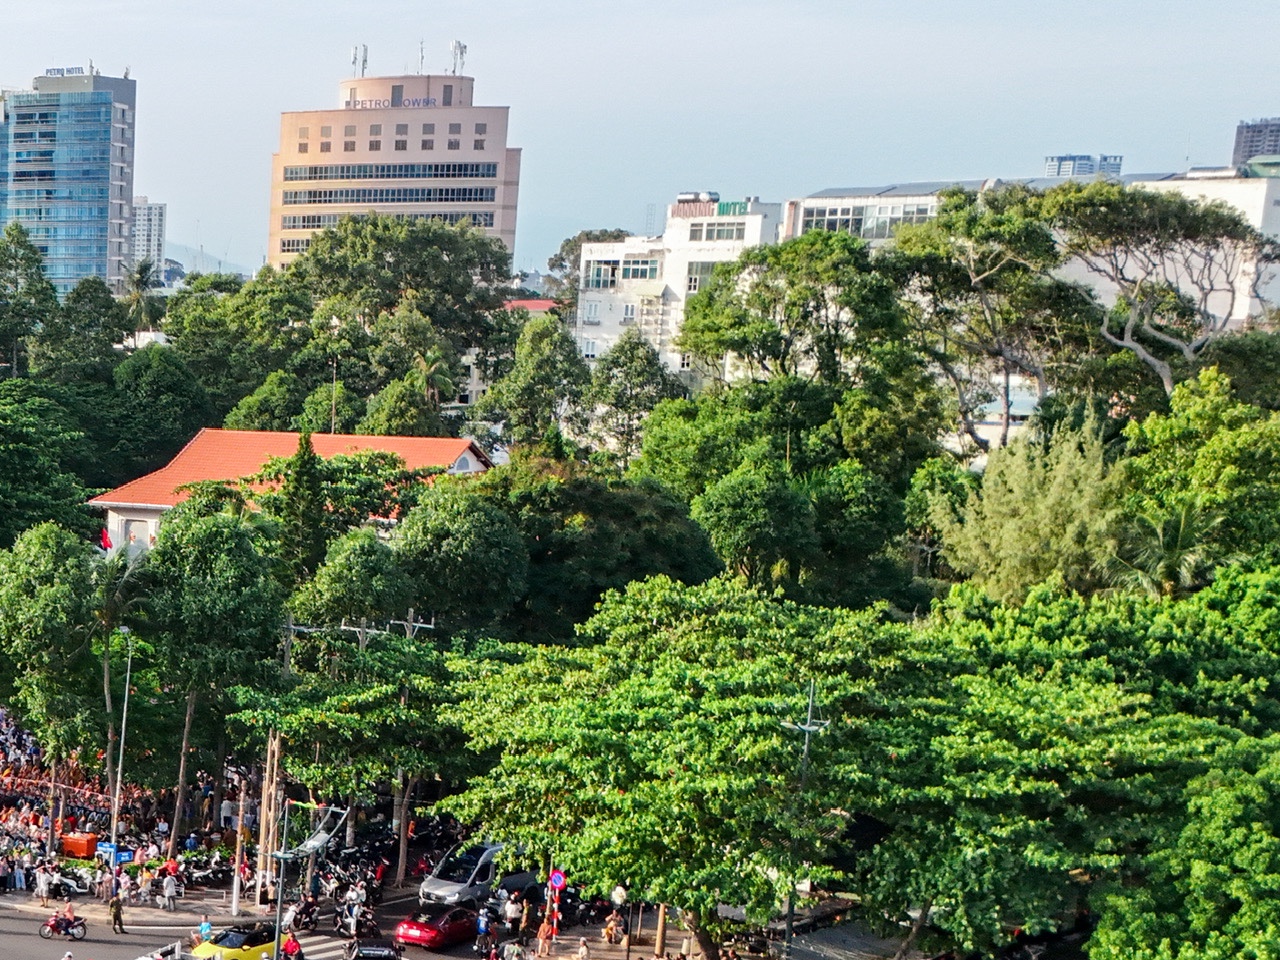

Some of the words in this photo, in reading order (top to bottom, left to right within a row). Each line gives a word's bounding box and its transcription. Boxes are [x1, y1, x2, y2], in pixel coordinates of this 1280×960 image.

[46, 68, 64, 76] PETRO
[66, 66, 84, 75] HOTEL
[353, 99, 390, 108] PETRO
